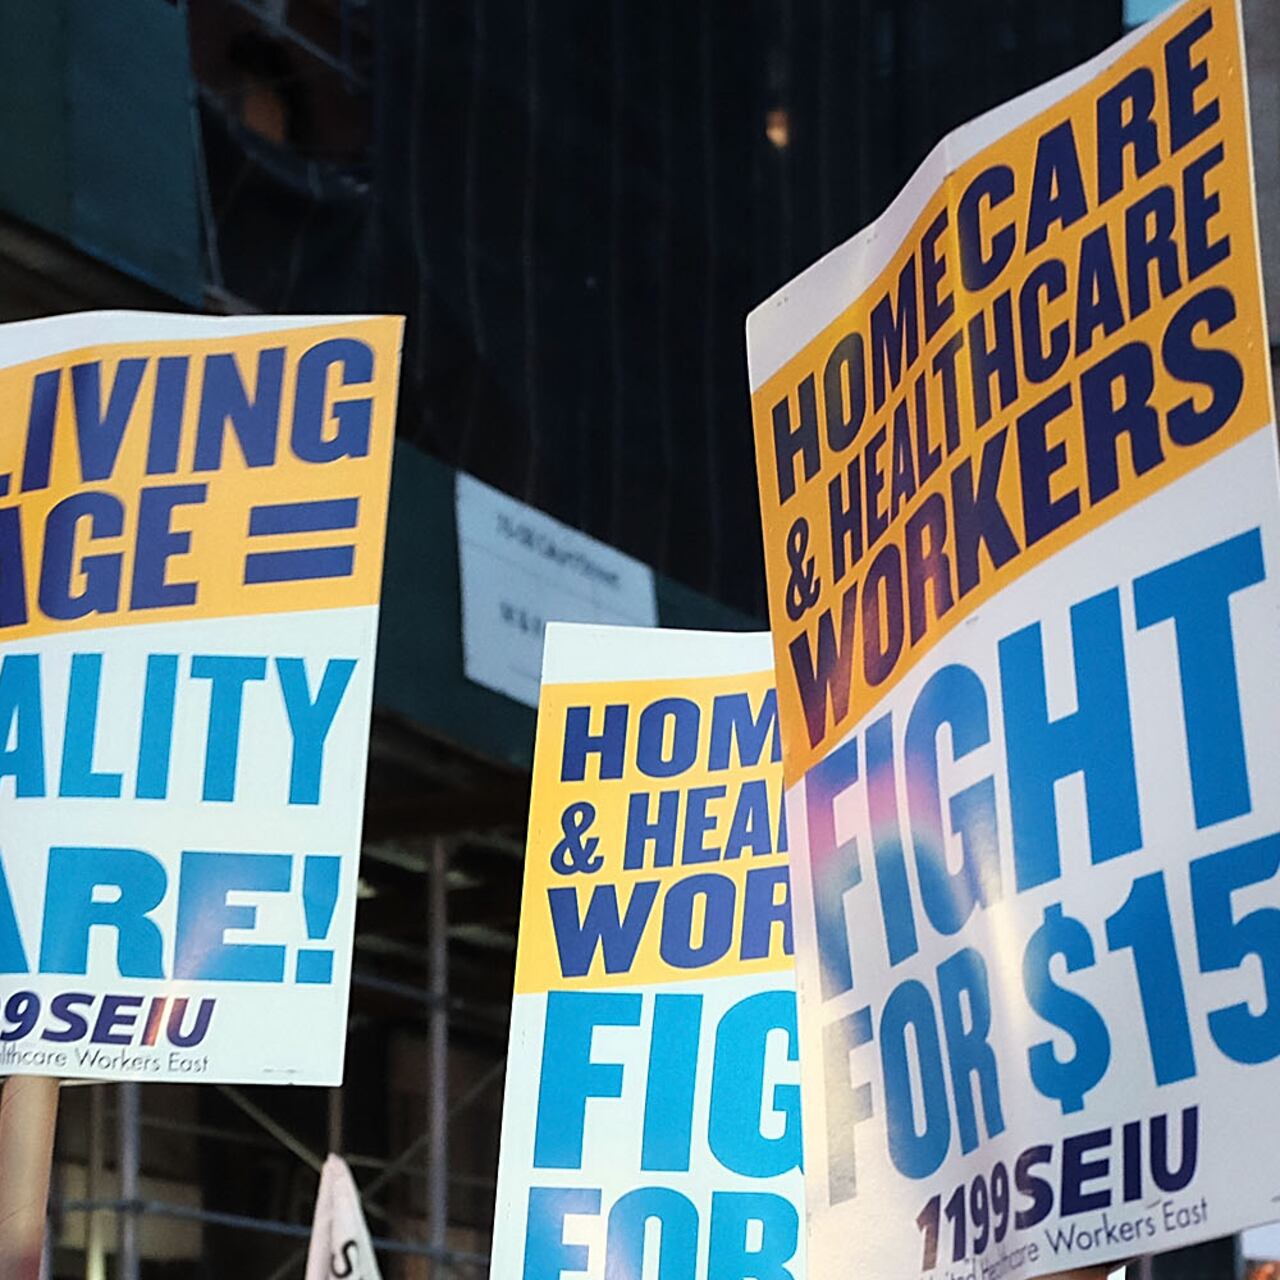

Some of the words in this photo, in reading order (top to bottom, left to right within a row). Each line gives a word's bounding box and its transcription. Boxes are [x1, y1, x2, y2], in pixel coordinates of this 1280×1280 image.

[771, 7, 1221, 504] HOMECARE
[785, 516, 822, 620] &
[828, 140, 1231, 584] HEALTHCARE
[789, 285, 1244, 751] WORKERS
[549, 801, 605, 876] &
[803, 526, 1267, 1002] FIGHT
[77, 1049, 160, 1072] Workers
[169, 1053, 208, 1074] East
[821, 946, 1006, 1208] FOR
[916, 1104, 1199, 1272] 1199SEIU
[1044, 1212, 1156, 1256] Workers
[1163, 1197, 1208, 1232] East
